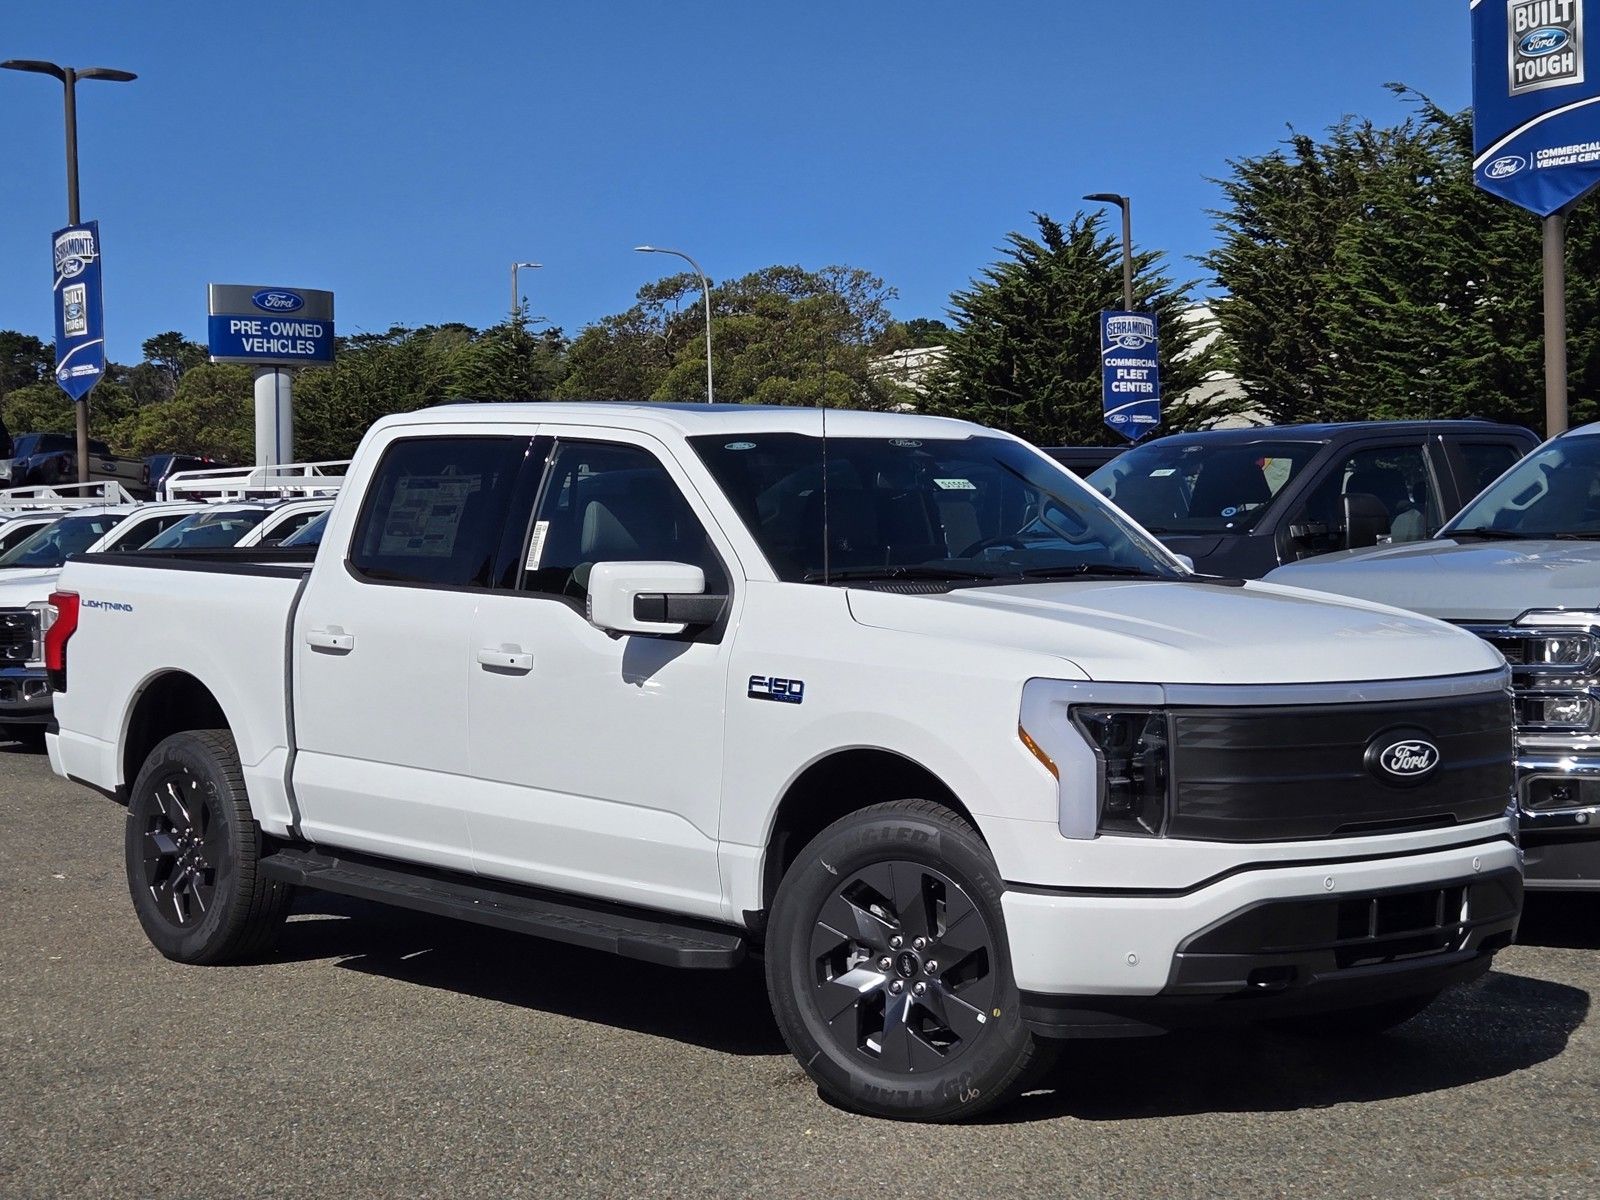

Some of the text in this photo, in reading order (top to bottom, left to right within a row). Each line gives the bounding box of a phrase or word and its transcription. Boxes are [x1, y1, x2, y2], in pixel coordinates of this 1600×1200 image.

[1515, 0, 1574, 32] BUILT
[1527, 32, 1557, 51] Ford
[1515, 52, 1574, 83] TOUGH
[1536, 141, 1600, 160] COMMERCIAL
[1491, 158, 1518, 176] Ford
[1536, 154, 1578, 169] VEHICLE
[264, 293, 295, 308] Ford
[230, 320, 323, 338] PRE-OWNED
[242, 338, 315, 354] VEHICLES
[1104, 357, 1157, 368] COMMERCIAL
[1116, 368, 1149, 380] FLEET
[1111, 381, 1154, 393] CENTER
[81, 599, 133, 612] LIGHTNING
[748, 675, 804, 697] F-150
[1391, 745, 1430, 771] Ford
